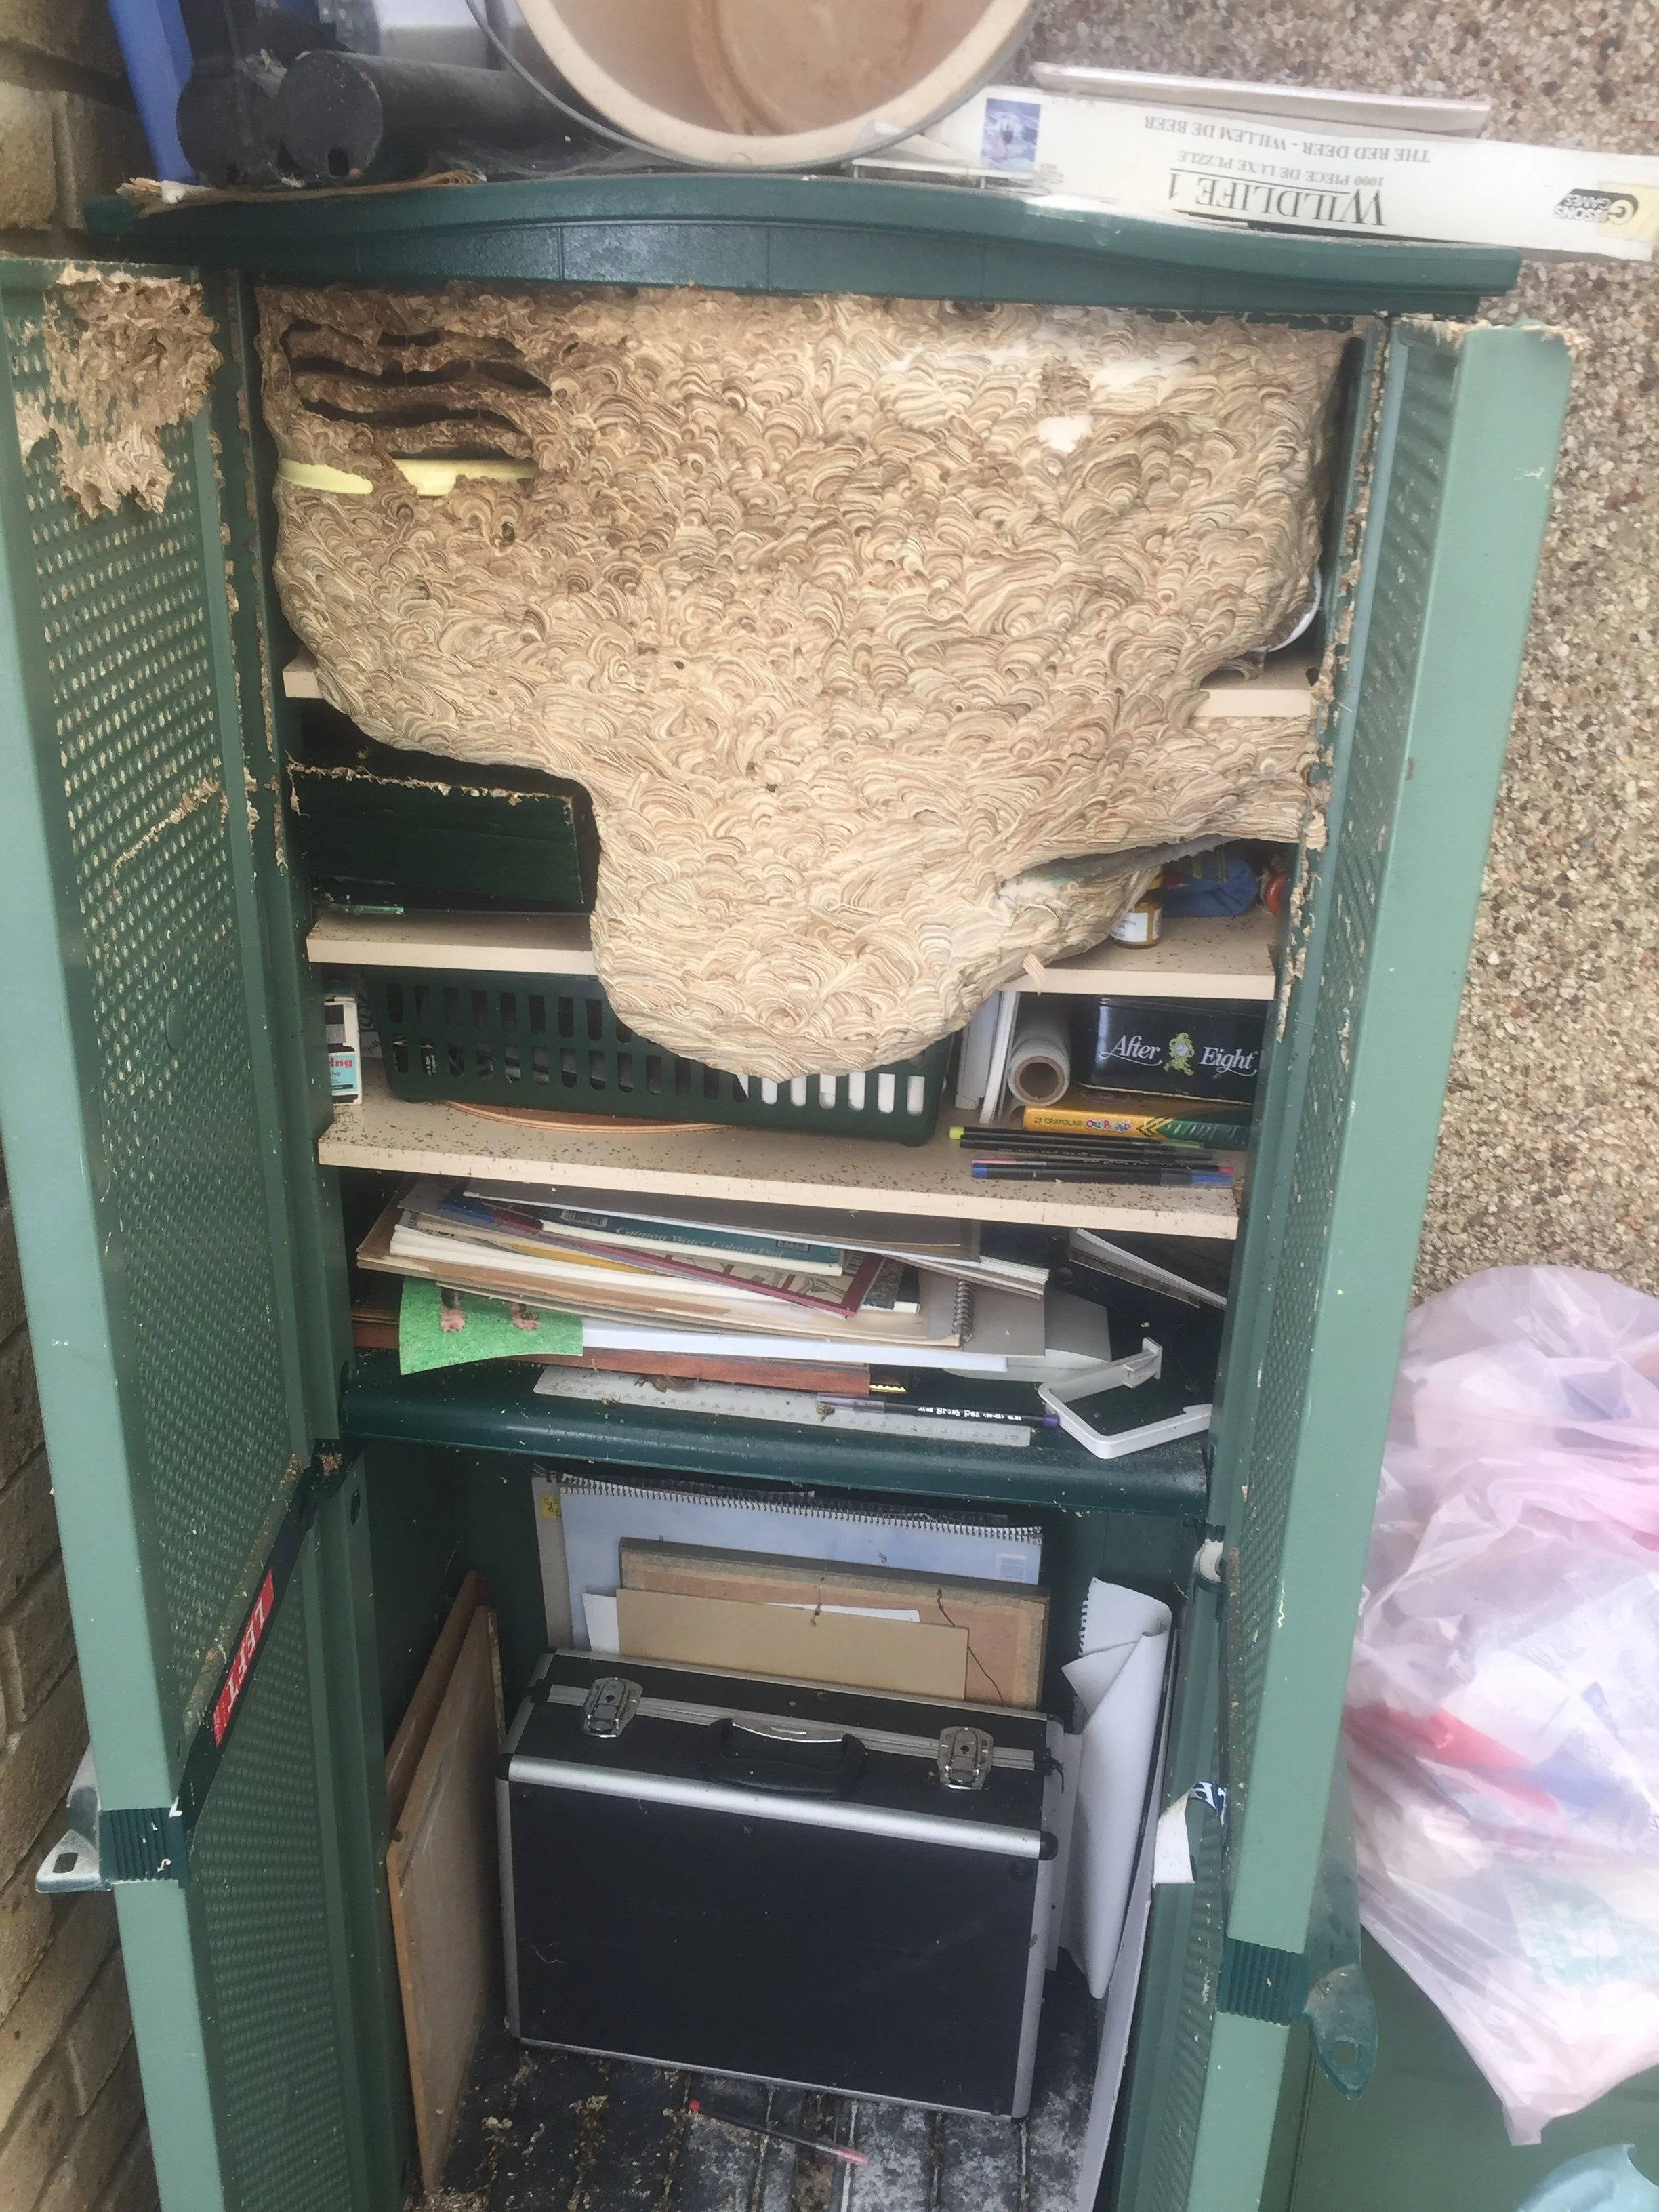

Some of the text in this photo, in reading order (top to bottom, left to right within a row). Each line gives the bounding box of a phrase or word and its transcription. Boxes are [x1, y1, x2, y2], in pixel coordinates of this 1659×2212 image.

[1144, 116, 1189, 134] BEER
[1191, 121, 1215, 139] DE
[1219, 126, 1288, 152] WILLEM
[1303, 140, 1350, 159] DEER
[1354, 146, 1391, 161] RED
[1393, 148, 1431, 163] THE
[1178, 150, 1385, 188] 1000 PIECE DE LUXE PUZZLE
[1167, 172, 1387, 228] WILDLIFE 1
[1563, 194, 1612, 210] GAMES
[1100, 1035, 1258, 1077] After Eight
[936, 1406, 960, 1416] Brush
[963, 1410, 981, 1418] Pen
[228, 1595, 265, 1712] LEFT
